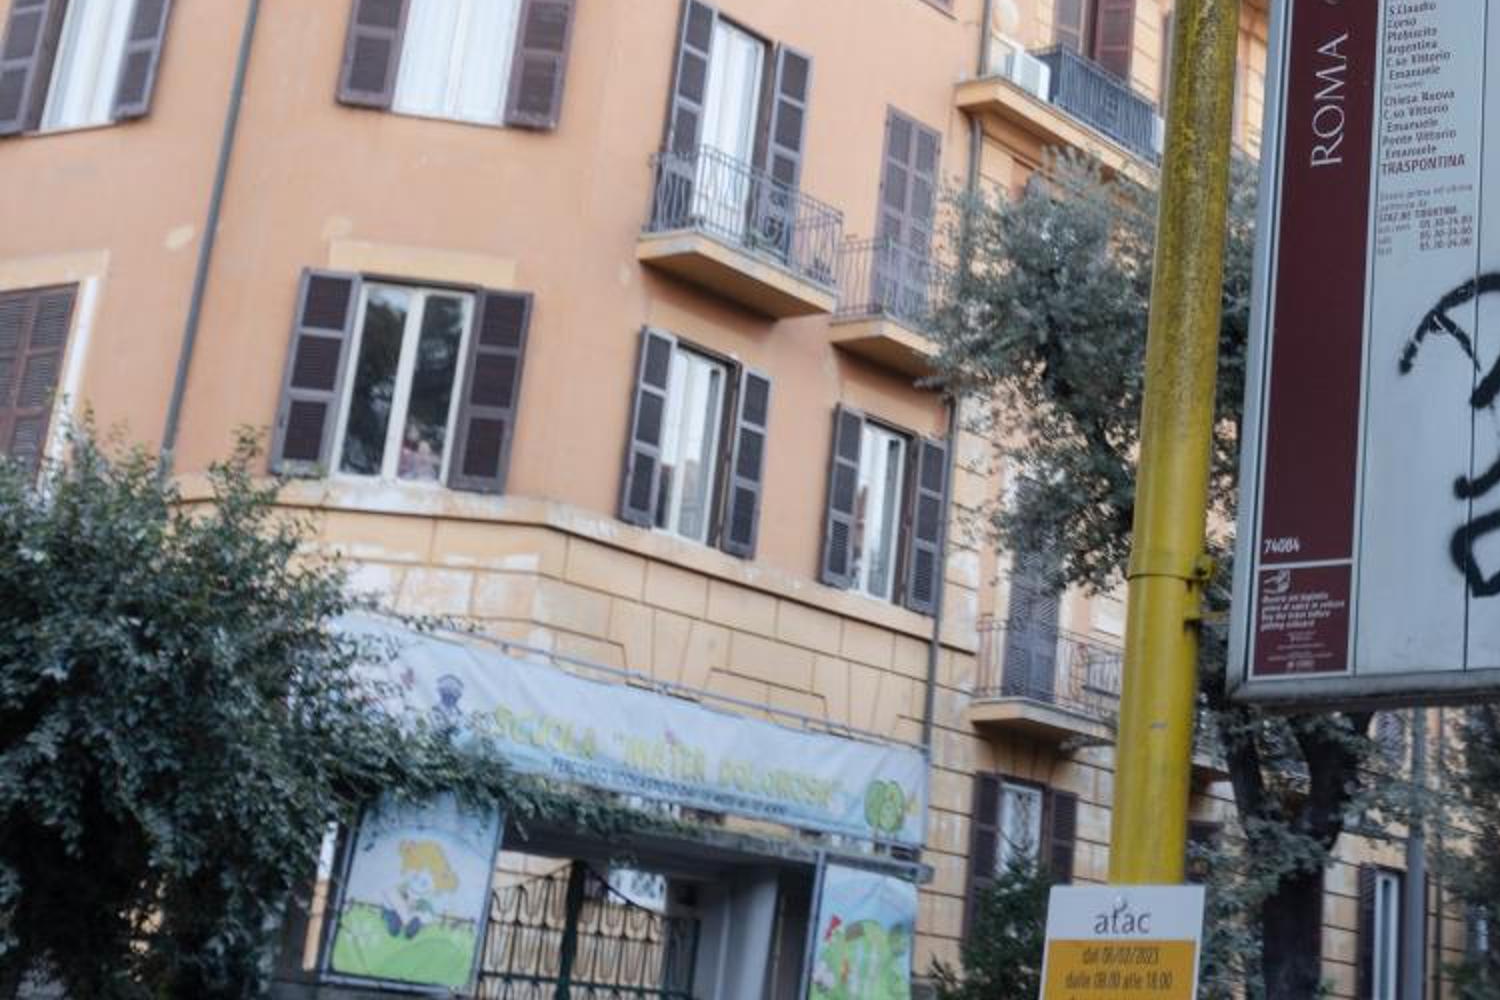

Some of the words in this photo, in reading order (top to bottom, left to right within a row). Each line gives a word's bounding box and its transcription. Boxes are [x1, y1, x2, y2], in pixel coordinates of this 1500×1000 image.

[1310, 33, 1349, 167] ROMA
[1381, 153, 1465, 175] TRASPONTINA
[493, 703, 597, 761] SCUOLA
[1094, 901, 1152, 935] atac
